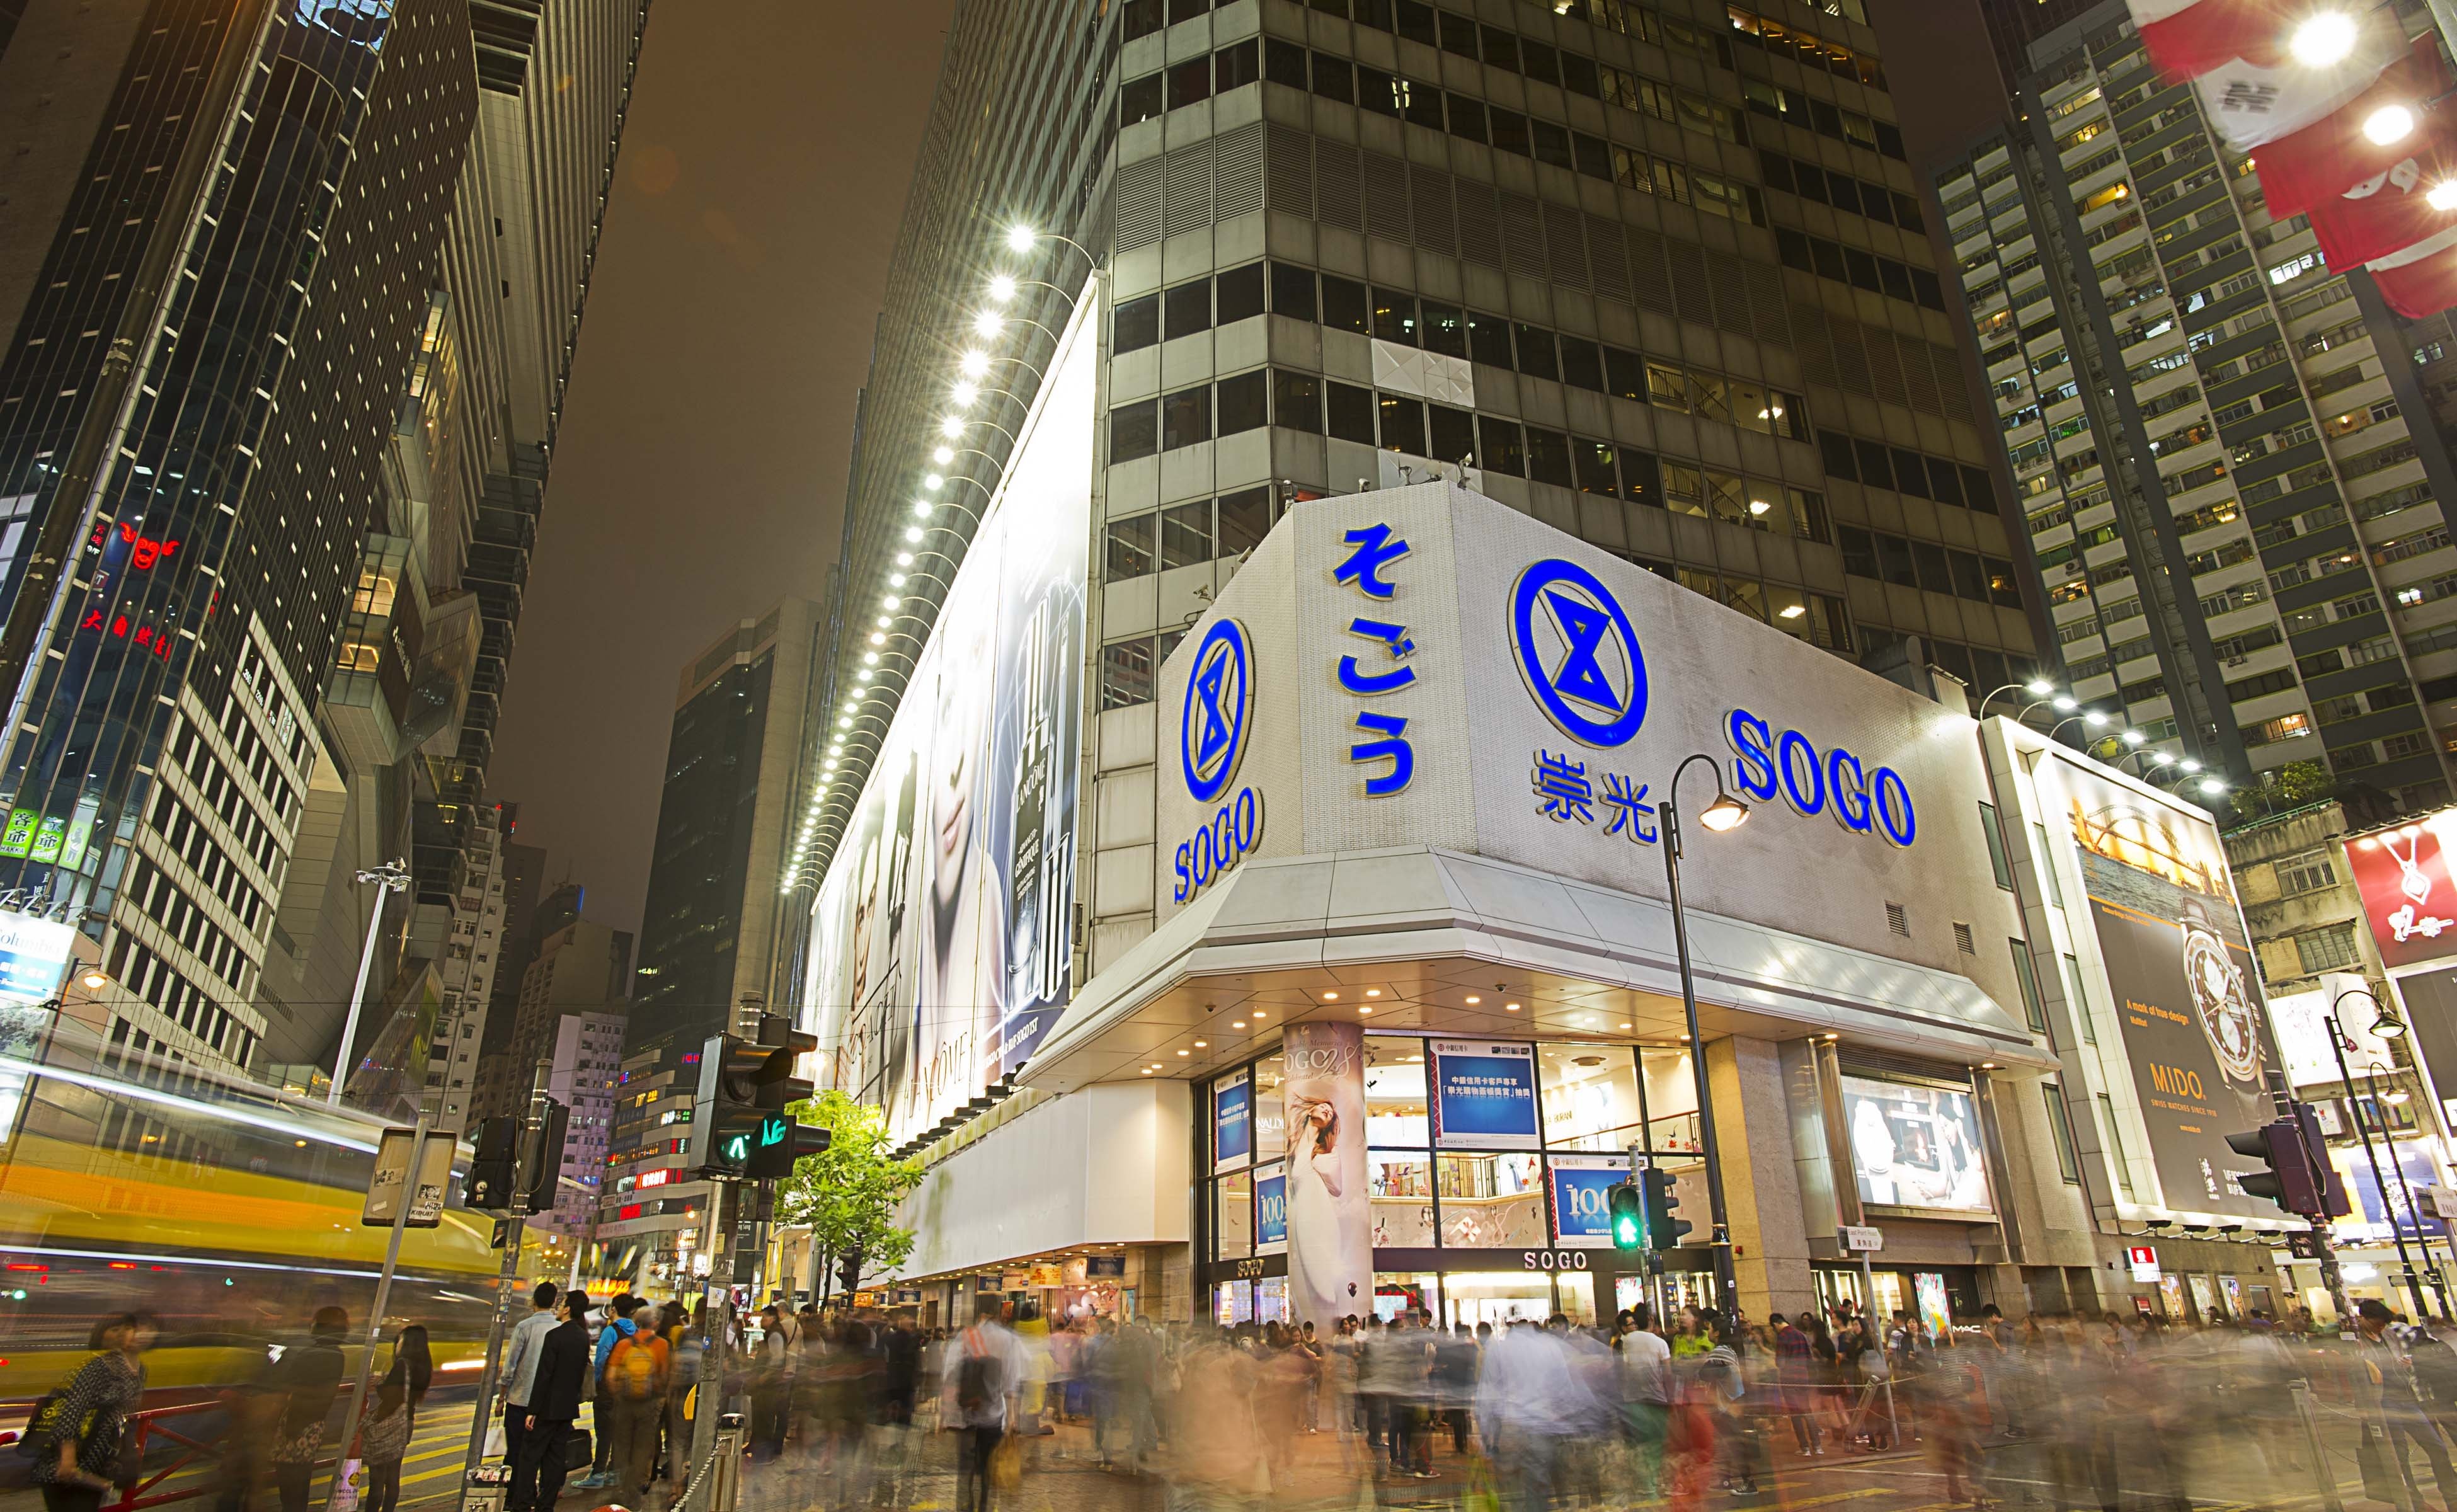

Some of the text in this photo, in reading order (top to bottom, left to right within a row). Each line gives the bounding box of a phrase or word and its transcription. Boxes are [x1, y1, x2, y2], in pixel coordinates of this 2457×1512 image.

[1332, 522, 1416, 798] そごう
[1724, 709, 1916, 849] SOGO
[1532, 749, 1658, 845] 崇光
[0, 845, 25, 854] HAKKA
[1174, 787, 1264, 905] SOGO
[2127, 999, 2189, 1026] A mark of true design
[1016, 1024, 1030, 1046] SOGO
[1029, 1016, 1039, 1036] TST
[1284, 1050, 1329, 1072] OGO
[2150, 1063, 2204, 1099] MIDO
[2151, 1099, 2167, 1108] SWISS
[2167, 1102, 2191, 1113] WATCHES
[2191, 1106, 2206, 1115] SINCE
[1524, 1251, 1587, 1269] SOGO
